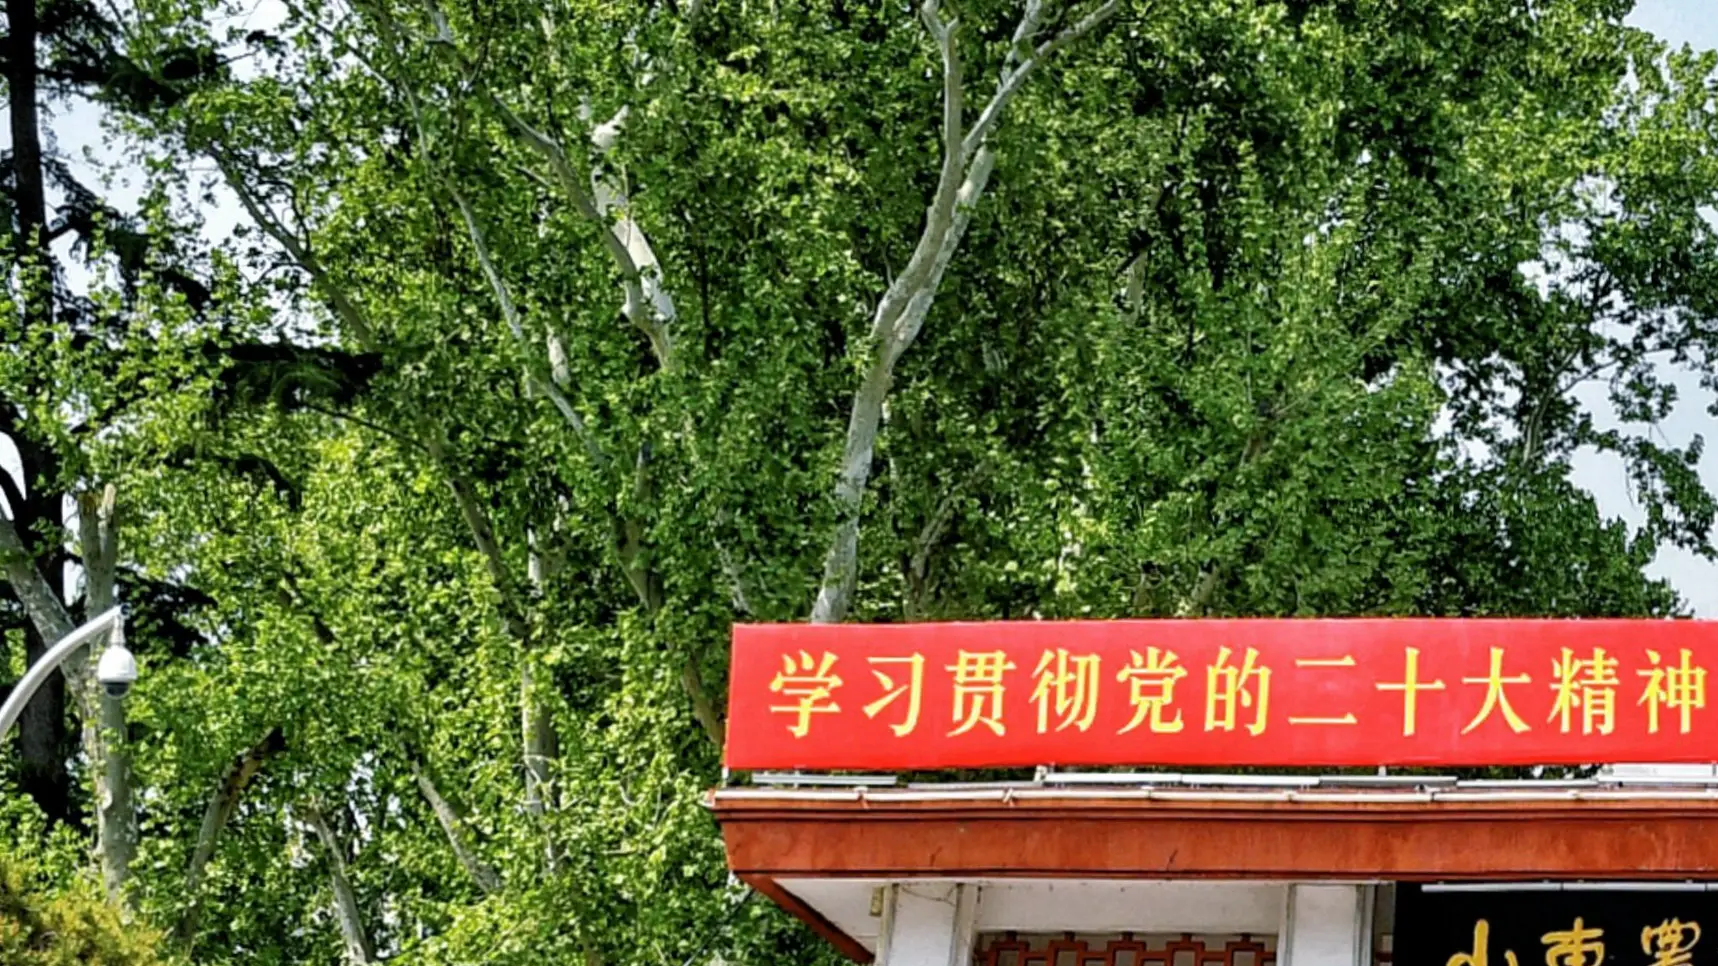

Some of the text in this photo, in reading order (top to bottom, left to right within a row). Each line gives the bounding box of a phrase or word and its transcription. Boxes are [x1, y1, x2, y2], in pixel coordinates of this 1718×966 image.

[769, 646, 1708, 738] 学习贯彻党的二十大精神
